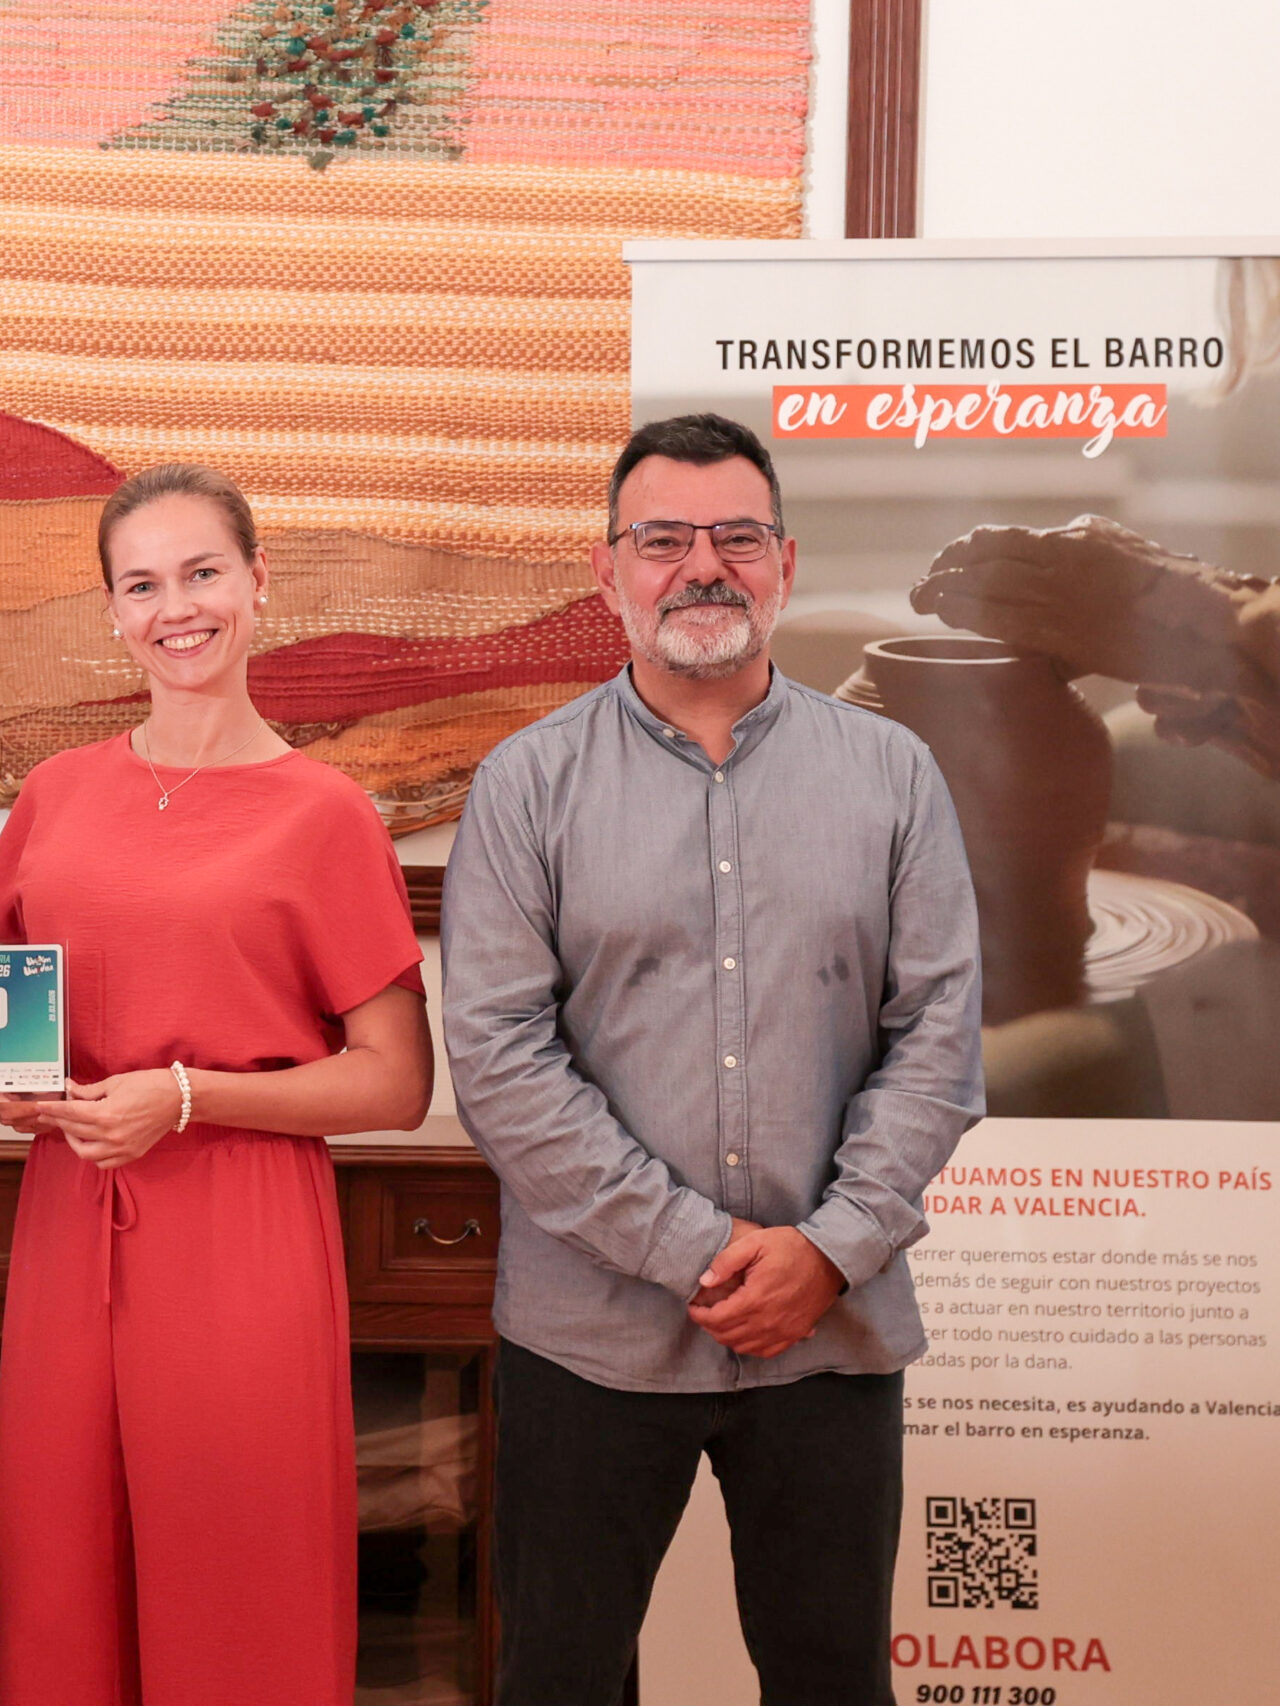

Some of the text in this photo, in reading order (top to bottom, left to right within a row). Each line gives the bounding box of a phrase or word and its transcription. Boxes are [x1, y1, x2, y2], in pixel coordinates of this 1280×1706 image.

[715, 337, 1225, 370] TRANSFORMEMOS EL BARRO
[777, 379, 1168, 459] en esperanza
[929, 1166, 1273, 1191] TUAMOS EN NUESTRO PAÍS
[924, 1195, 1147, 1218] DAR A VALENCIA.
[907, 1248, 1259, 1268] errer queremos estar donde más se nos
[914, 1272, 1262, 1297] demás de seguir con nuestros proyectos
[934, 1302, 945, 1314] a
[949, 1301, 1003, 1316] actuar
[1008, 1303, 1030, 1316] en
[1034, 1302, 1103, 1318] nuestro
[1106, 1302, 1186, 1320] territorio
[1189, 1303, 1236, 1323] junto
[1239, 1307, 1250, 1320] a
[953, 1326, 993, 1342] todo
[998, 1329, 1065, 1344] nuestro
[1069, 1328, 1140, 1345] cuidado
[1144, 1331, 1155, 1345] a
[1159, 1329, 1184, 1346] las
[1188, 1332, 1268, 1350] personas
[971, 1354, 1001, 1371] por
[1005, 1353, 1020, 1369] la
[1024, 1354, 1073, 1371] dana.
[917, 1397, 937, 1409] se
[942, 1398, 974, 1411] nos
[979, 1396, 1062, 1416] necesita,
[1066, 1399, 1087, 1413] es
[1091, 1399, 1185, 1418] ayudando
[1189, 1403, 1201, 1415] a
[1205, 1400, 1280, 1417] Valencia
[904, 1421, 1151, 1444] mar el barro en esperanza.
[890, 1633, 1112, 1672] OLABORA
[916, 1684, 1056, 1706] 900 111 300
